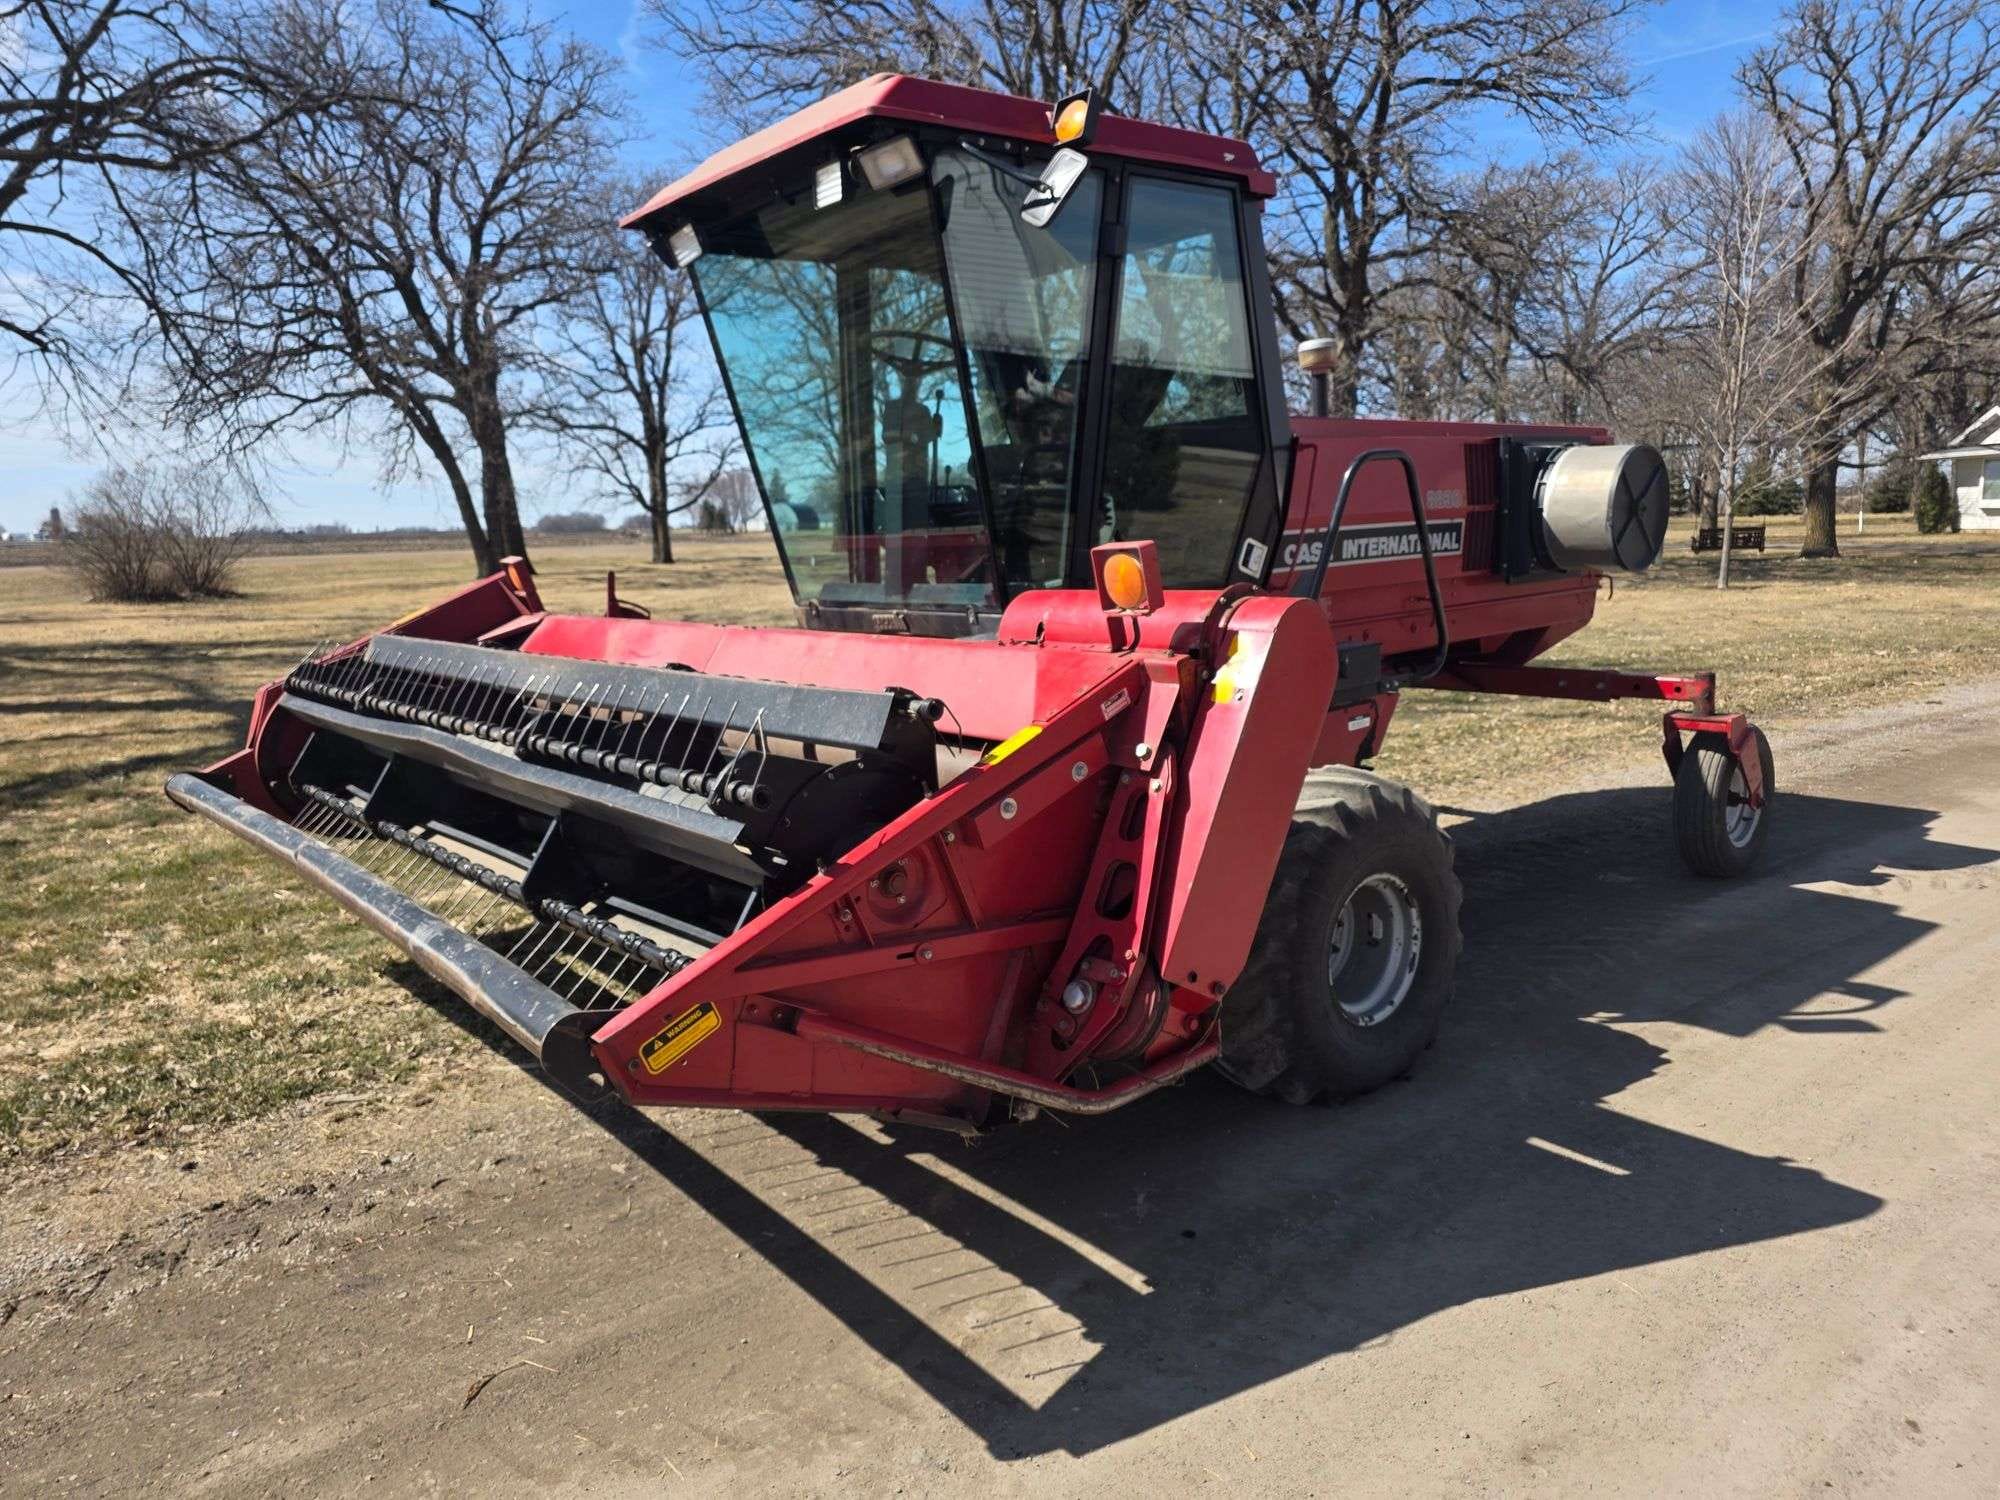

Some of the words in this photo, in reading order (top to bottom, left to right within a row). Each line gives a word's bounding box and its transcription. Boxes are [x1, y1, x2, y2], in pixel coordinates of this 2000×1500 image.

[1284, 541, 1334, 566] CAS
[1342, 531, 1459, 560] INTERNATINAL
[666, 1009, 703, 1039] WARNING
